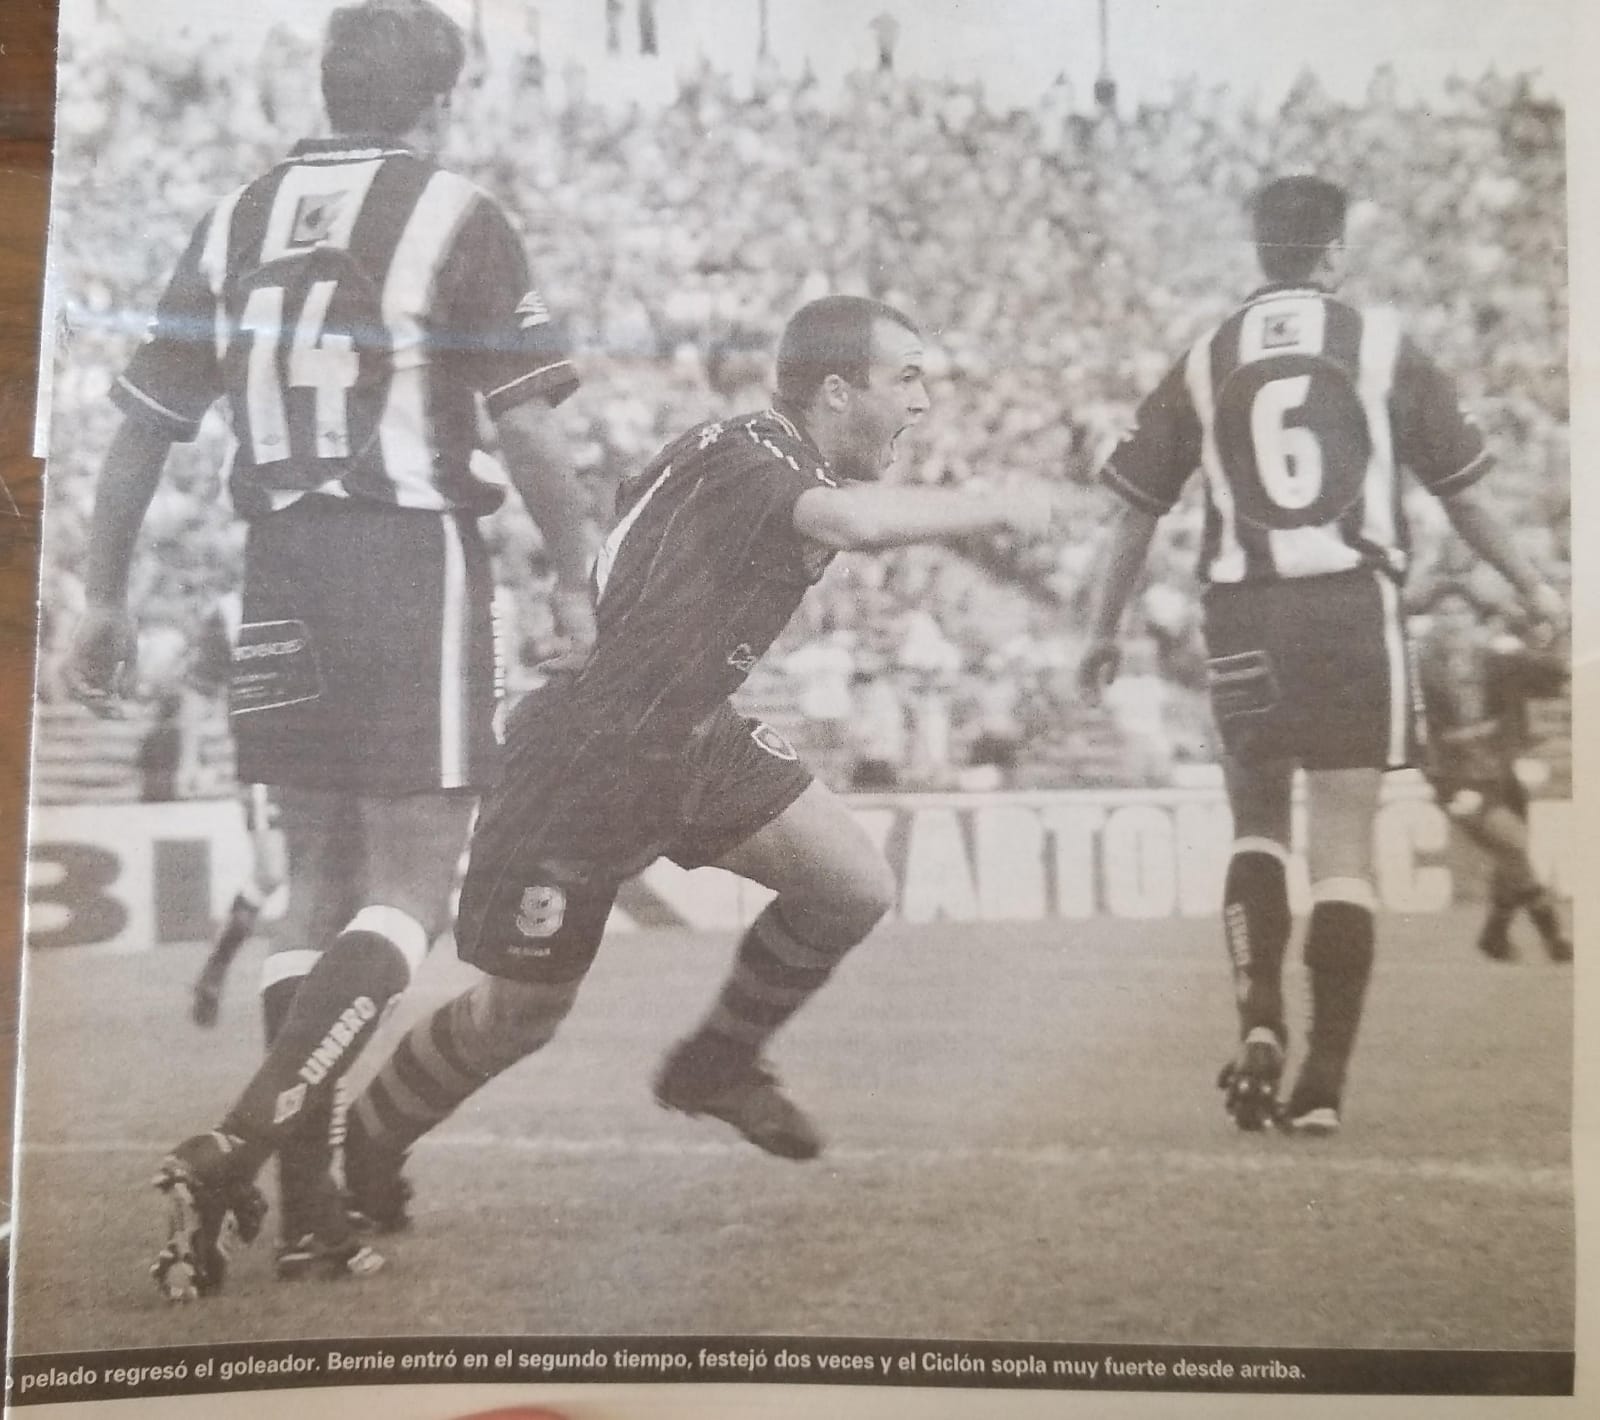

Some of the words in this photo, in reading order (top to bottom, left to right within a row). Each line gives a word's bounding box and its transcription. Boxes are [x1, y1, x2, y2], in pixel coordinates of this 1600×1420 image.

[240, 280, 361, 465] 14
[1250, 374, 1324, 510] 6
[299, 995, 378, 1086] UMBRO
[20, 1365, 98, 1394] pelado
[104, 1359, 188, 1386] regresó
[194, 1358, 214, 1378] el
[219, 1353, 321, 1381] goleador.
[327, 1350, 396, 1371] Bernie
[400, 1349, 458, 1369] entró
[463, 1353, 489, 1368] en
[494, 1348, 513, 1368] el
[518, 1348, 608, 1372] segundo
[613, 1348, 693, 1372] tiempo,
[698, 1348, 768, 1372] festejó
[773, 1348, 812, 1369] dos
[816, 1354, 875, 1370] veces
[879, 1356, 893, 1375] y
[898, 1351, 916, 1371] el
[921, 1351, 986, 1373] Ciclón
[991, 1354, 1047, 1378] sopla
[1053, 1360, 1099, 1379] muy
[1103, 1356, 1167, 1377] fuerte
[1172, 1358, 1235, 1378] desde
[1240, 1359, 1306, 1379] arriba.
